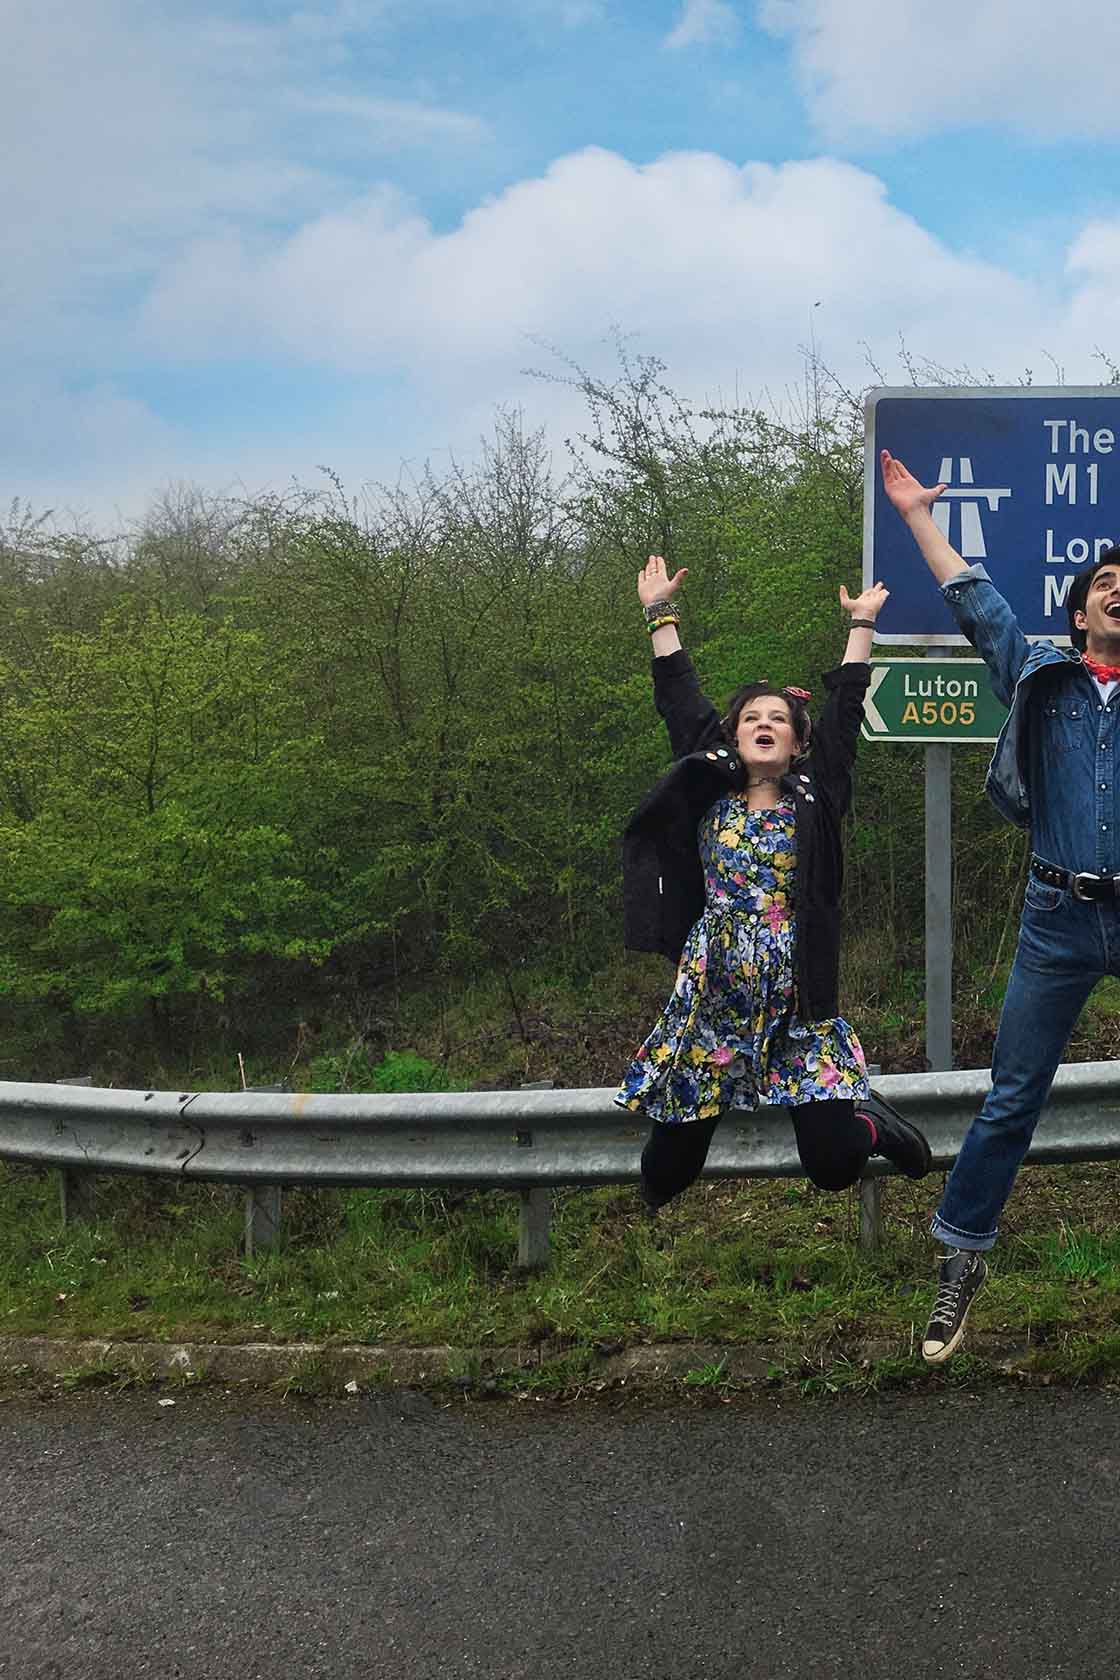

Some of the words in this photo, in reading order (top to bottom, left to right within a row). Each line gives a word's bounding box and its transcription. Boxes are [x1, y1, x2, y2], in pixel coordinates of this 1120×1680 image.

[1043, 420, 1115, 453] The
[1045, 463, 1098, 505] M1
[1044, 575, 1076, 616] M
[904, 674, 978, 697] Luton
[901, 702, 976, 725] A505
